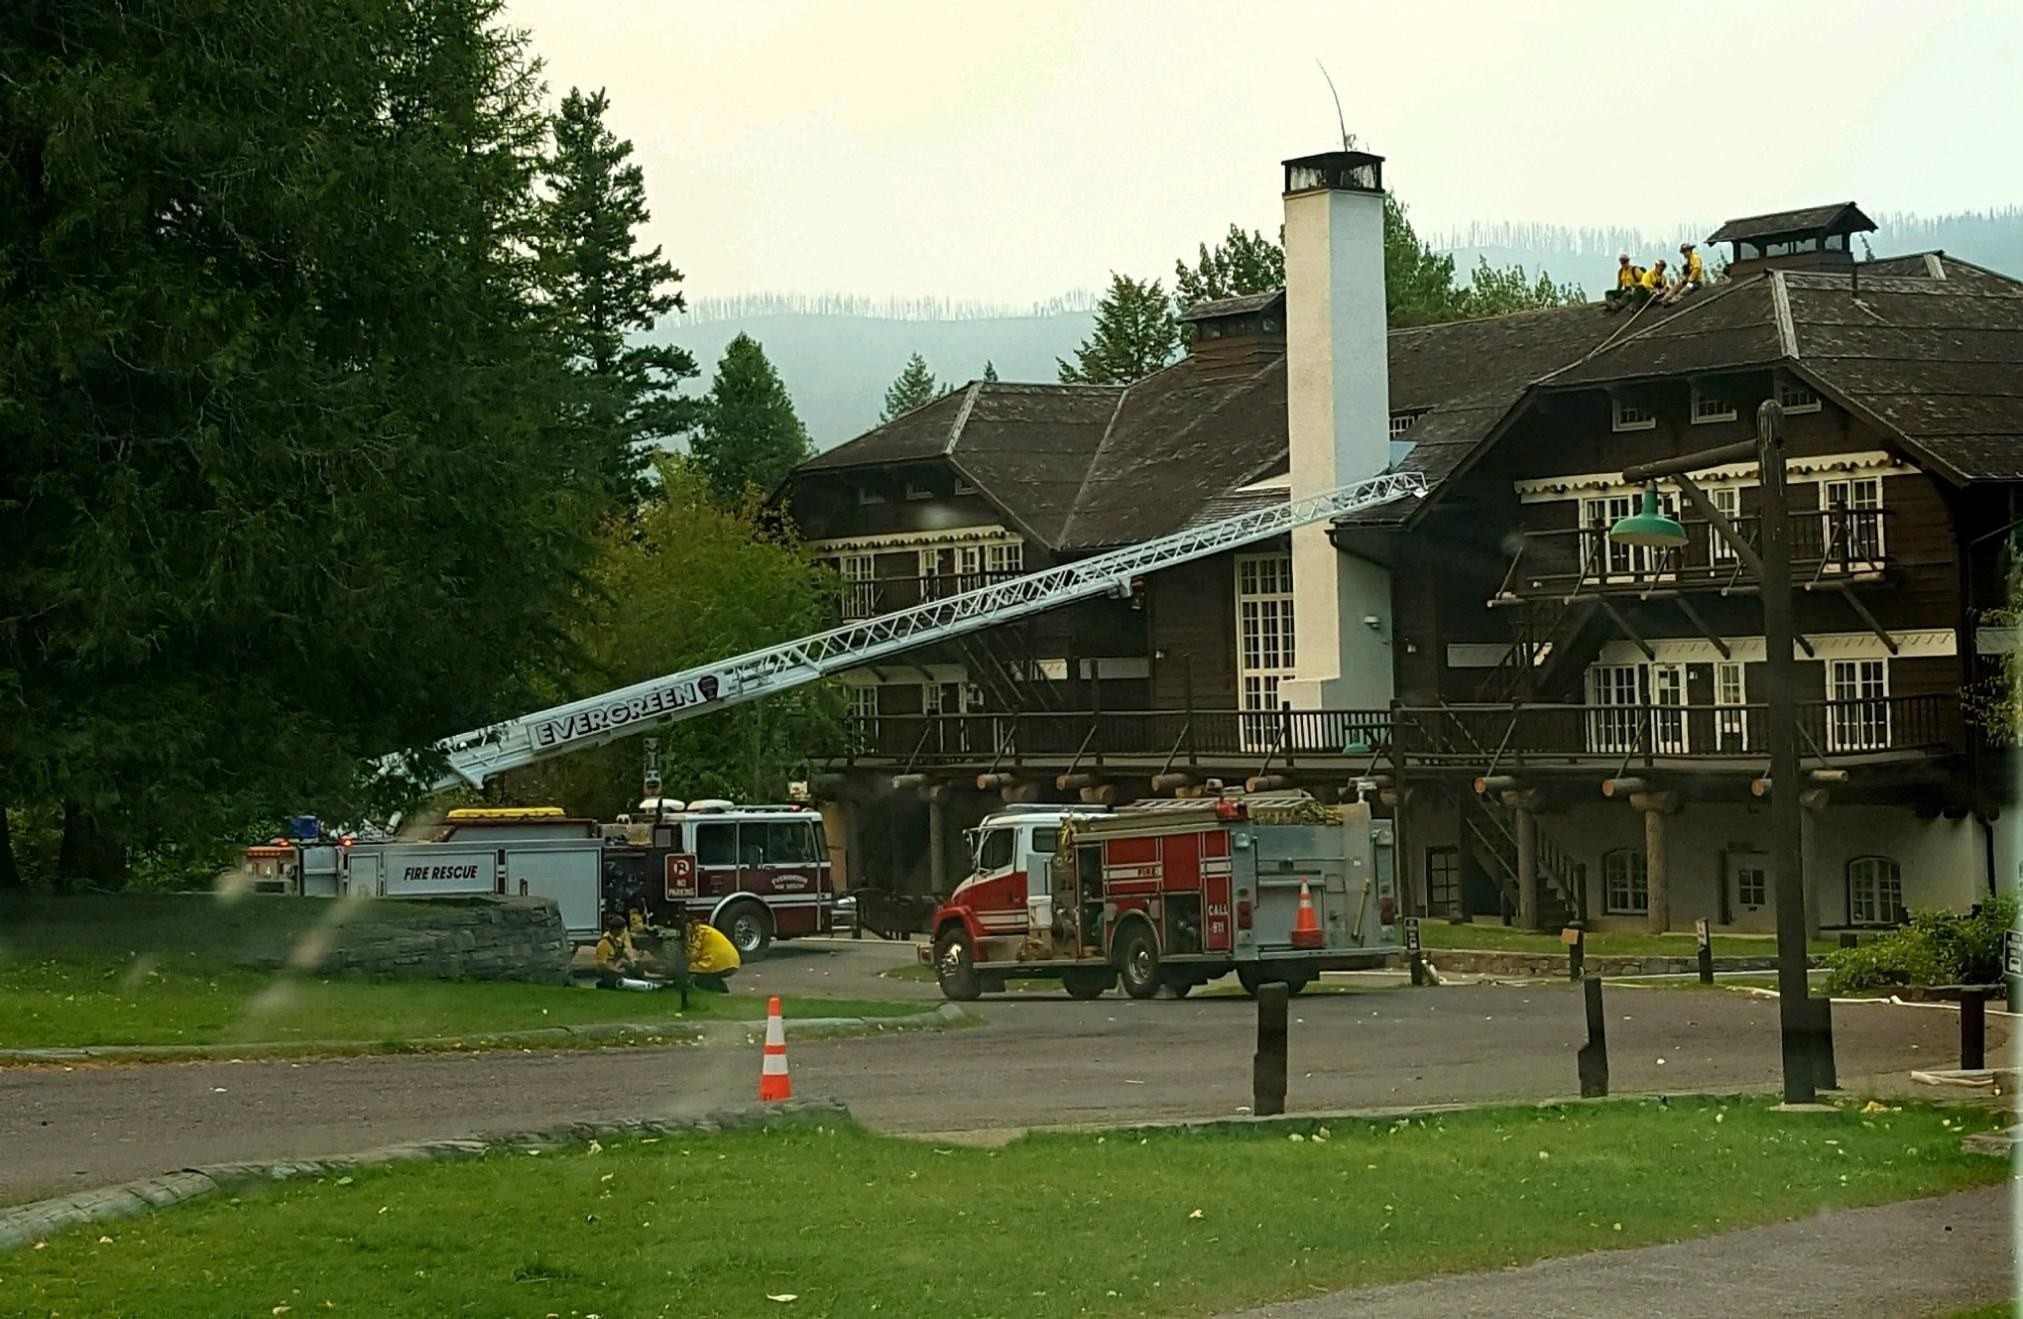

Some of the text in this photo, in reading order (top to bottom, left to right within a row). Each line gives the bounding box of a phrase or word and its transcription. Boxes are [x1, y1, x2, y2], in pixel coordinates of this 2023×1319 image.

[536, 683, 697, 745] EVERGREEN
[404, 865, 478, 880] FIRE RESCUE
[1208, 904, 1228, 916] CALL
